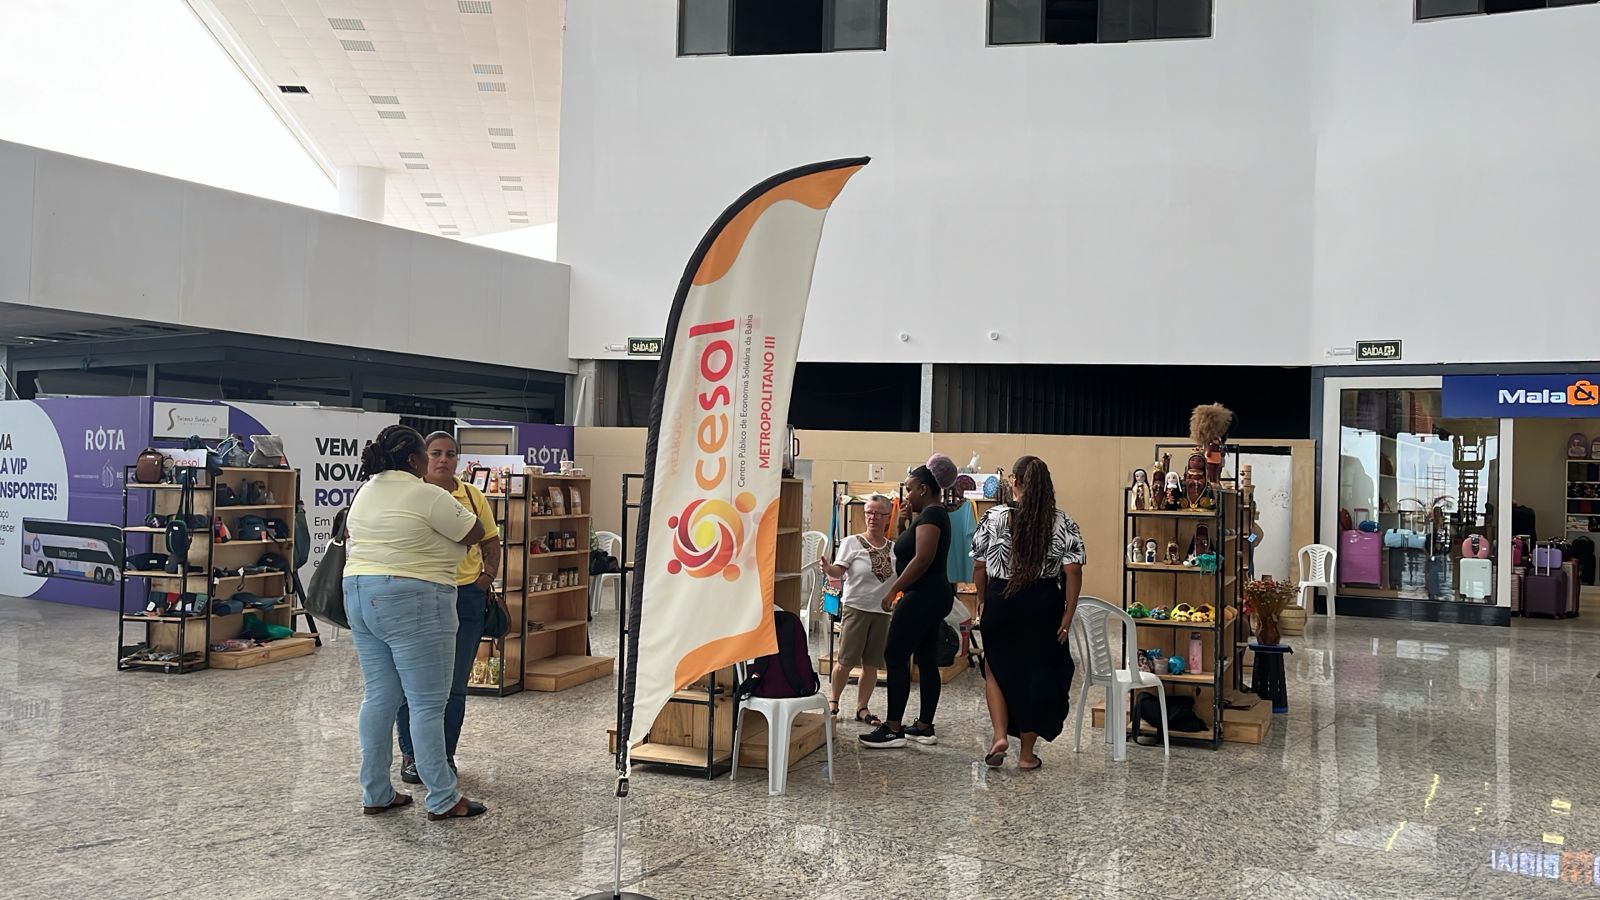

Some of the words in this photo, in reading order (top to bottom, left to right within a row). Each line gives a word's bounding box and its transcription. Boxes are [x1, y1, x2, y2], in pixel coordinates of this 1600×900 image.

[745, 314, 753, 335] Bahia
[632, 341, 649, 352] SAÍDA
[745, 336, 752, 346] da
[764, 336, 776, 349] III
[1361, 344, 1384, 356] SAÍDA
[742, 347, 751, 378] Solidária
[689, 319, 735, 491] cesol
[740, 380, 749, 417] Economia
[1498, 389, 1567, 404] Mala
[759, 351, 775, 468] METROPOLITANO
[740, 419, 748, 429] de
[85, 427, 126, 451] ROTA
[315, 437, 358, 457] VEM
[739, 431, 747, 458] Público
[527, 446, 569, 465] ROTA
[10, 457, 28, 475] VIP
[738, 460, 746, 487] Centro
[0, 481, 57, 501] NSPORTES!
[315, 488, 356, 507] ROT
[314, 517, 330, 527] Em
